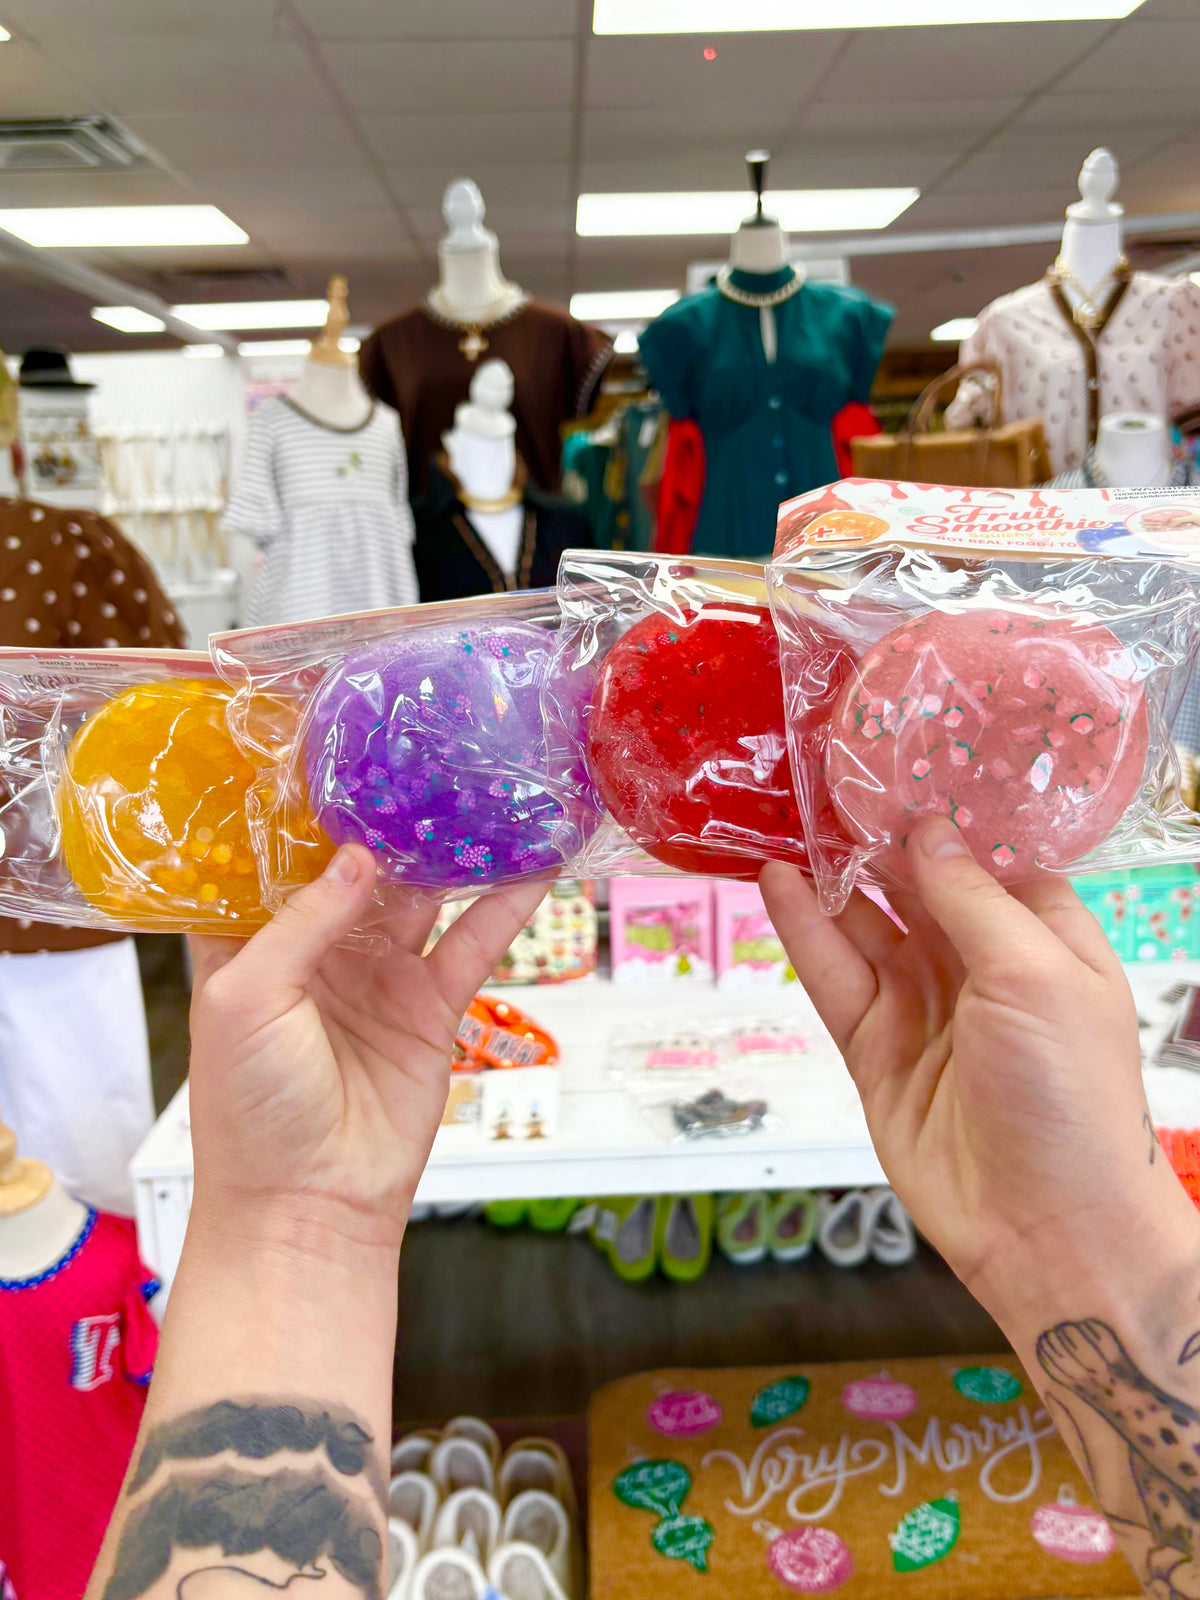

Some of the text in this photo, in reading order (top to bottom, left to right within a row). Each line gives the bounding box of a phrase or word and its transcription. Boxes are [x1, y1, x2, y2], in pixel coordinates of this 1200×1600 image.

[905, 514, 1113, 534] Smoothie
[945, 505, 1066, 523] Fruit
[783, 526, 834, 553] 3+
[702, 1407, 1056, 1521] Very Merry
